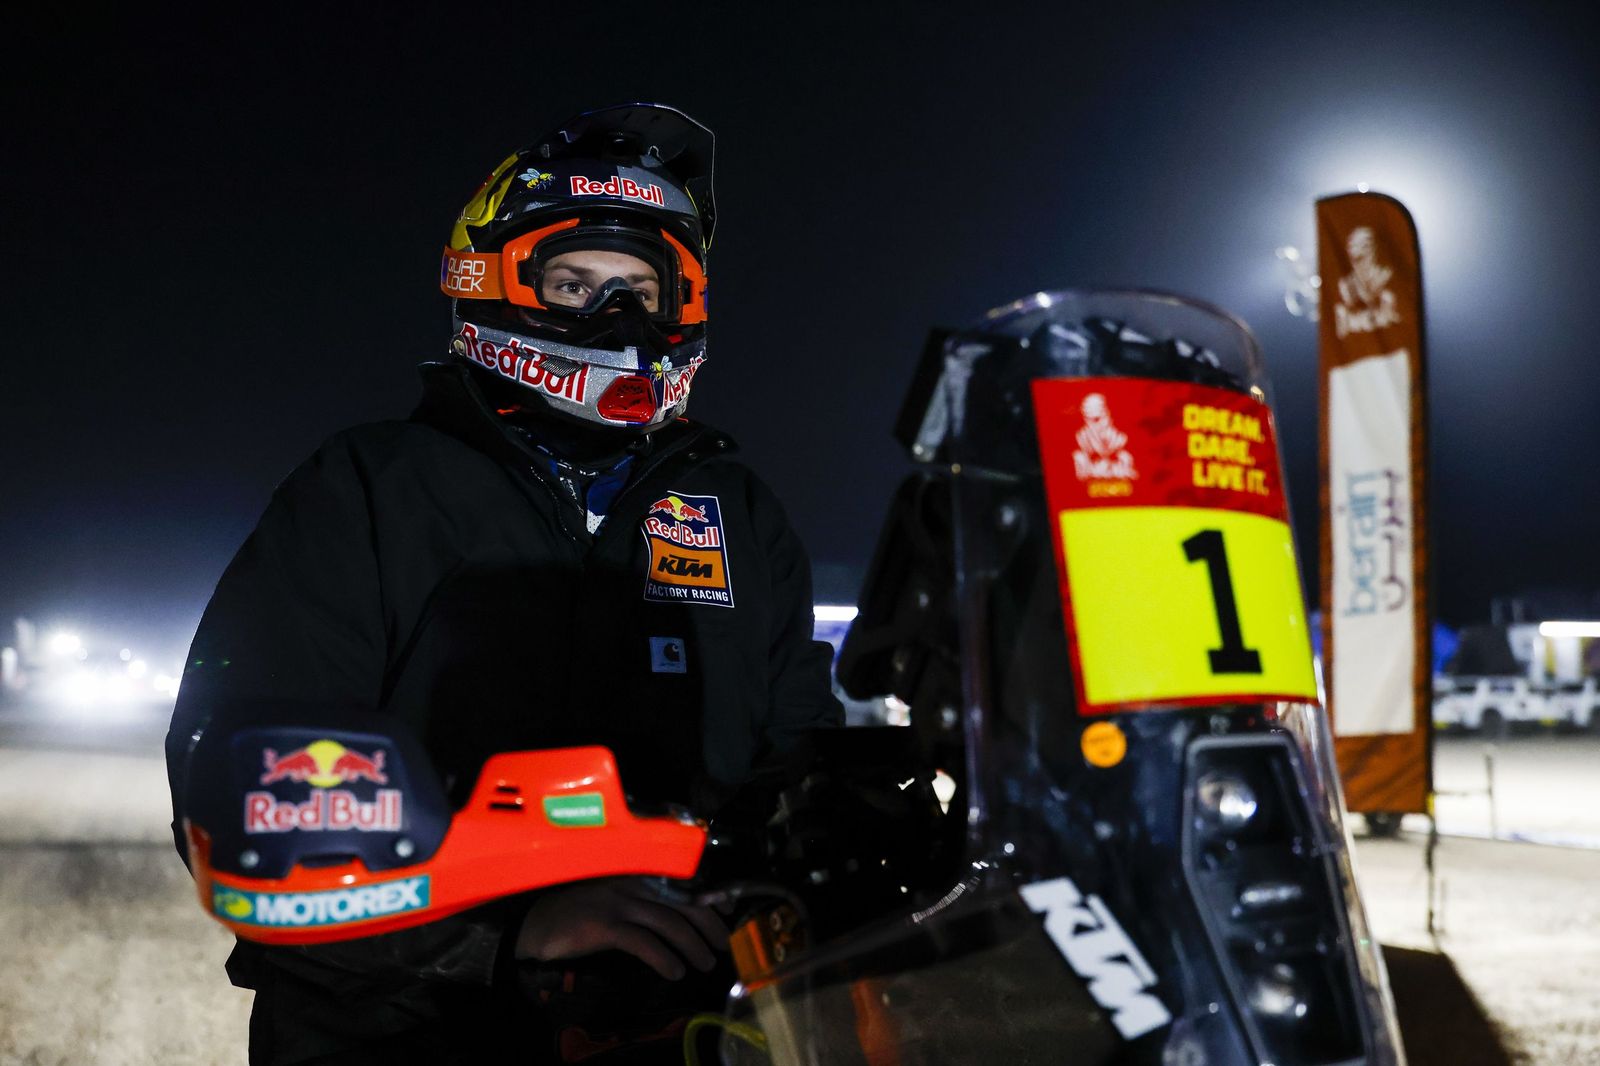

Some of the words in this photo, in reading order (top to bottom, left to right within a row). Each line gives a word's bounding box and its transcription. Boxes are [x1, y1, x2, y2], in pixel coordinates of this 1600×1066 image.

[570, 176, 620, 196] Red
[621, 178, 665, 207] Bull
[447, 273, 485, 292] LOCK
[448, 257, 486, 276] QUAD
[460, 322, 521, 379] Red
[1183, 404, 1264, 442] DREAM.
[1187, 432, 1255, 466] DARE.
[1193, 462, 1243, 492] LIVE
[1247, 470, 1269, 496] IT.
[645, 517, 681, 543] Red
[681, 526, 720, 547] Bull
[657, 554, 713, 578] KTM
[647, 584, 688, 598] FACTORY
[692, 589, 729, 602] RACING
[1181, 529, 1263, 674] 1
[244, 790, 326, 833] Red
[325, 788, 403, 832] Bull
[256, 878, 421, 925] MOTOREX
[1019, 875, 1172, 1041] KTM
